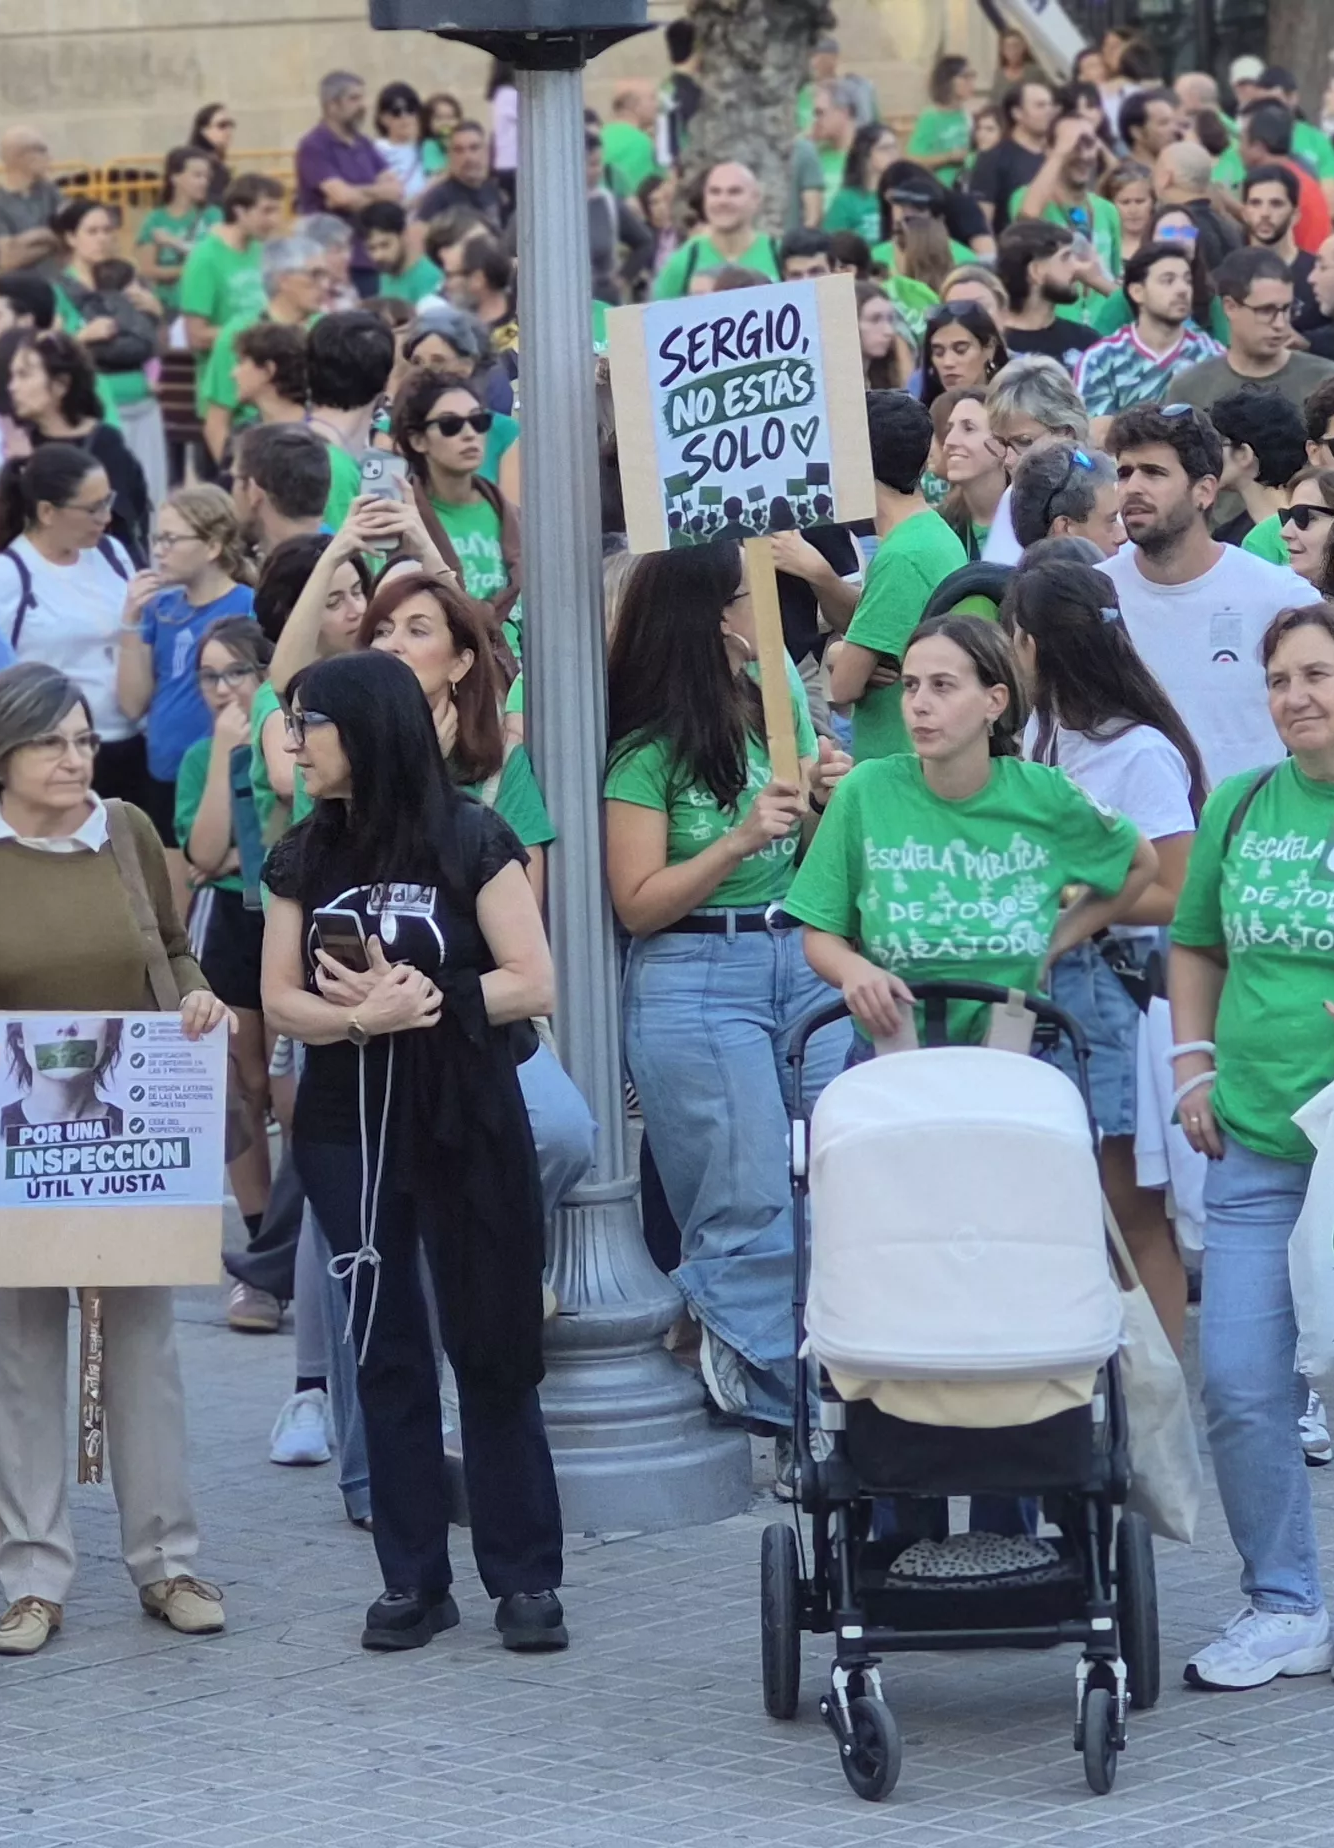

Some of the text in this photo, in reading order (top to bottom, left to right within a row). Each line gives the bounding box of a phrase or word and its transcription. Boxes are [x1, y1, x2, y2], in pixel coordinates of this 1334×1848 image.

[659, 303, 809, 388] SERGIO,
[672, 360, 810, 430] NO ESTÁS
[681, 417, 785, 485] SOLO
[867, 845, 956, 877] ESCUELA
[888, 901, 925, 922] DE
[1240, 887, 1278, 904] DE
[19, 1120, 106, 1145] POR UNA
[14, 1140, 183, 1176] INSPECCIÓN
[26, 1174, 166, 1199] ÚTIL Y JUSTA
